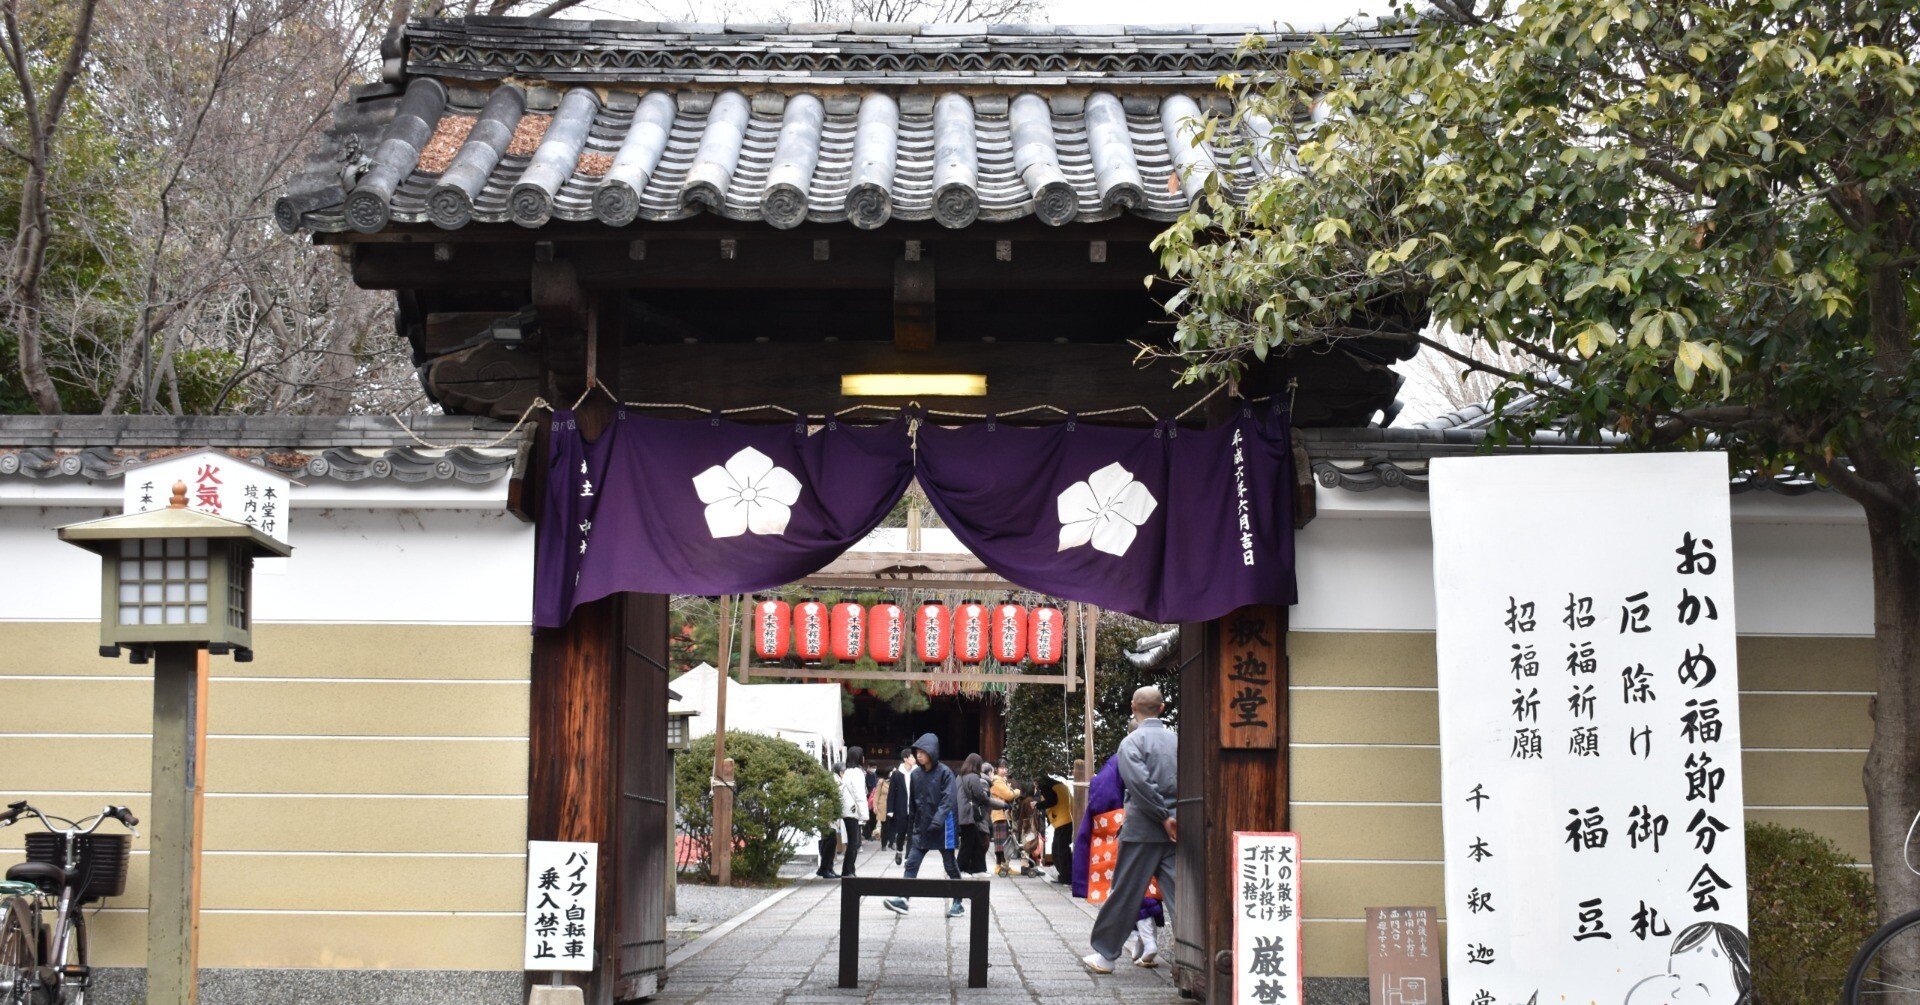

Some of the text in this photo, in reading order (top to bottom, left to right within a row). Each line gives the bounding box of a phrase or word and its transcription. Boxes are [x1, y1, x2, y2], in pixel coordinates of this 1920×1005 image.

[195, 464, 223, 516] 火気
[1504, 595, 1543, 760] 招福祈願
[1675, 531, 1734, 913] おかめ福節分会
[533, 866, 560, 959] 乗入禁止
[562, 851, 589, 958] バイク・自転車
[1243, 845, 1260, 919] ゴミ捨て
[1259, 845, 1276, 922] ボール投げ
[1277, 845, 1293, 922] 犬の散歩
